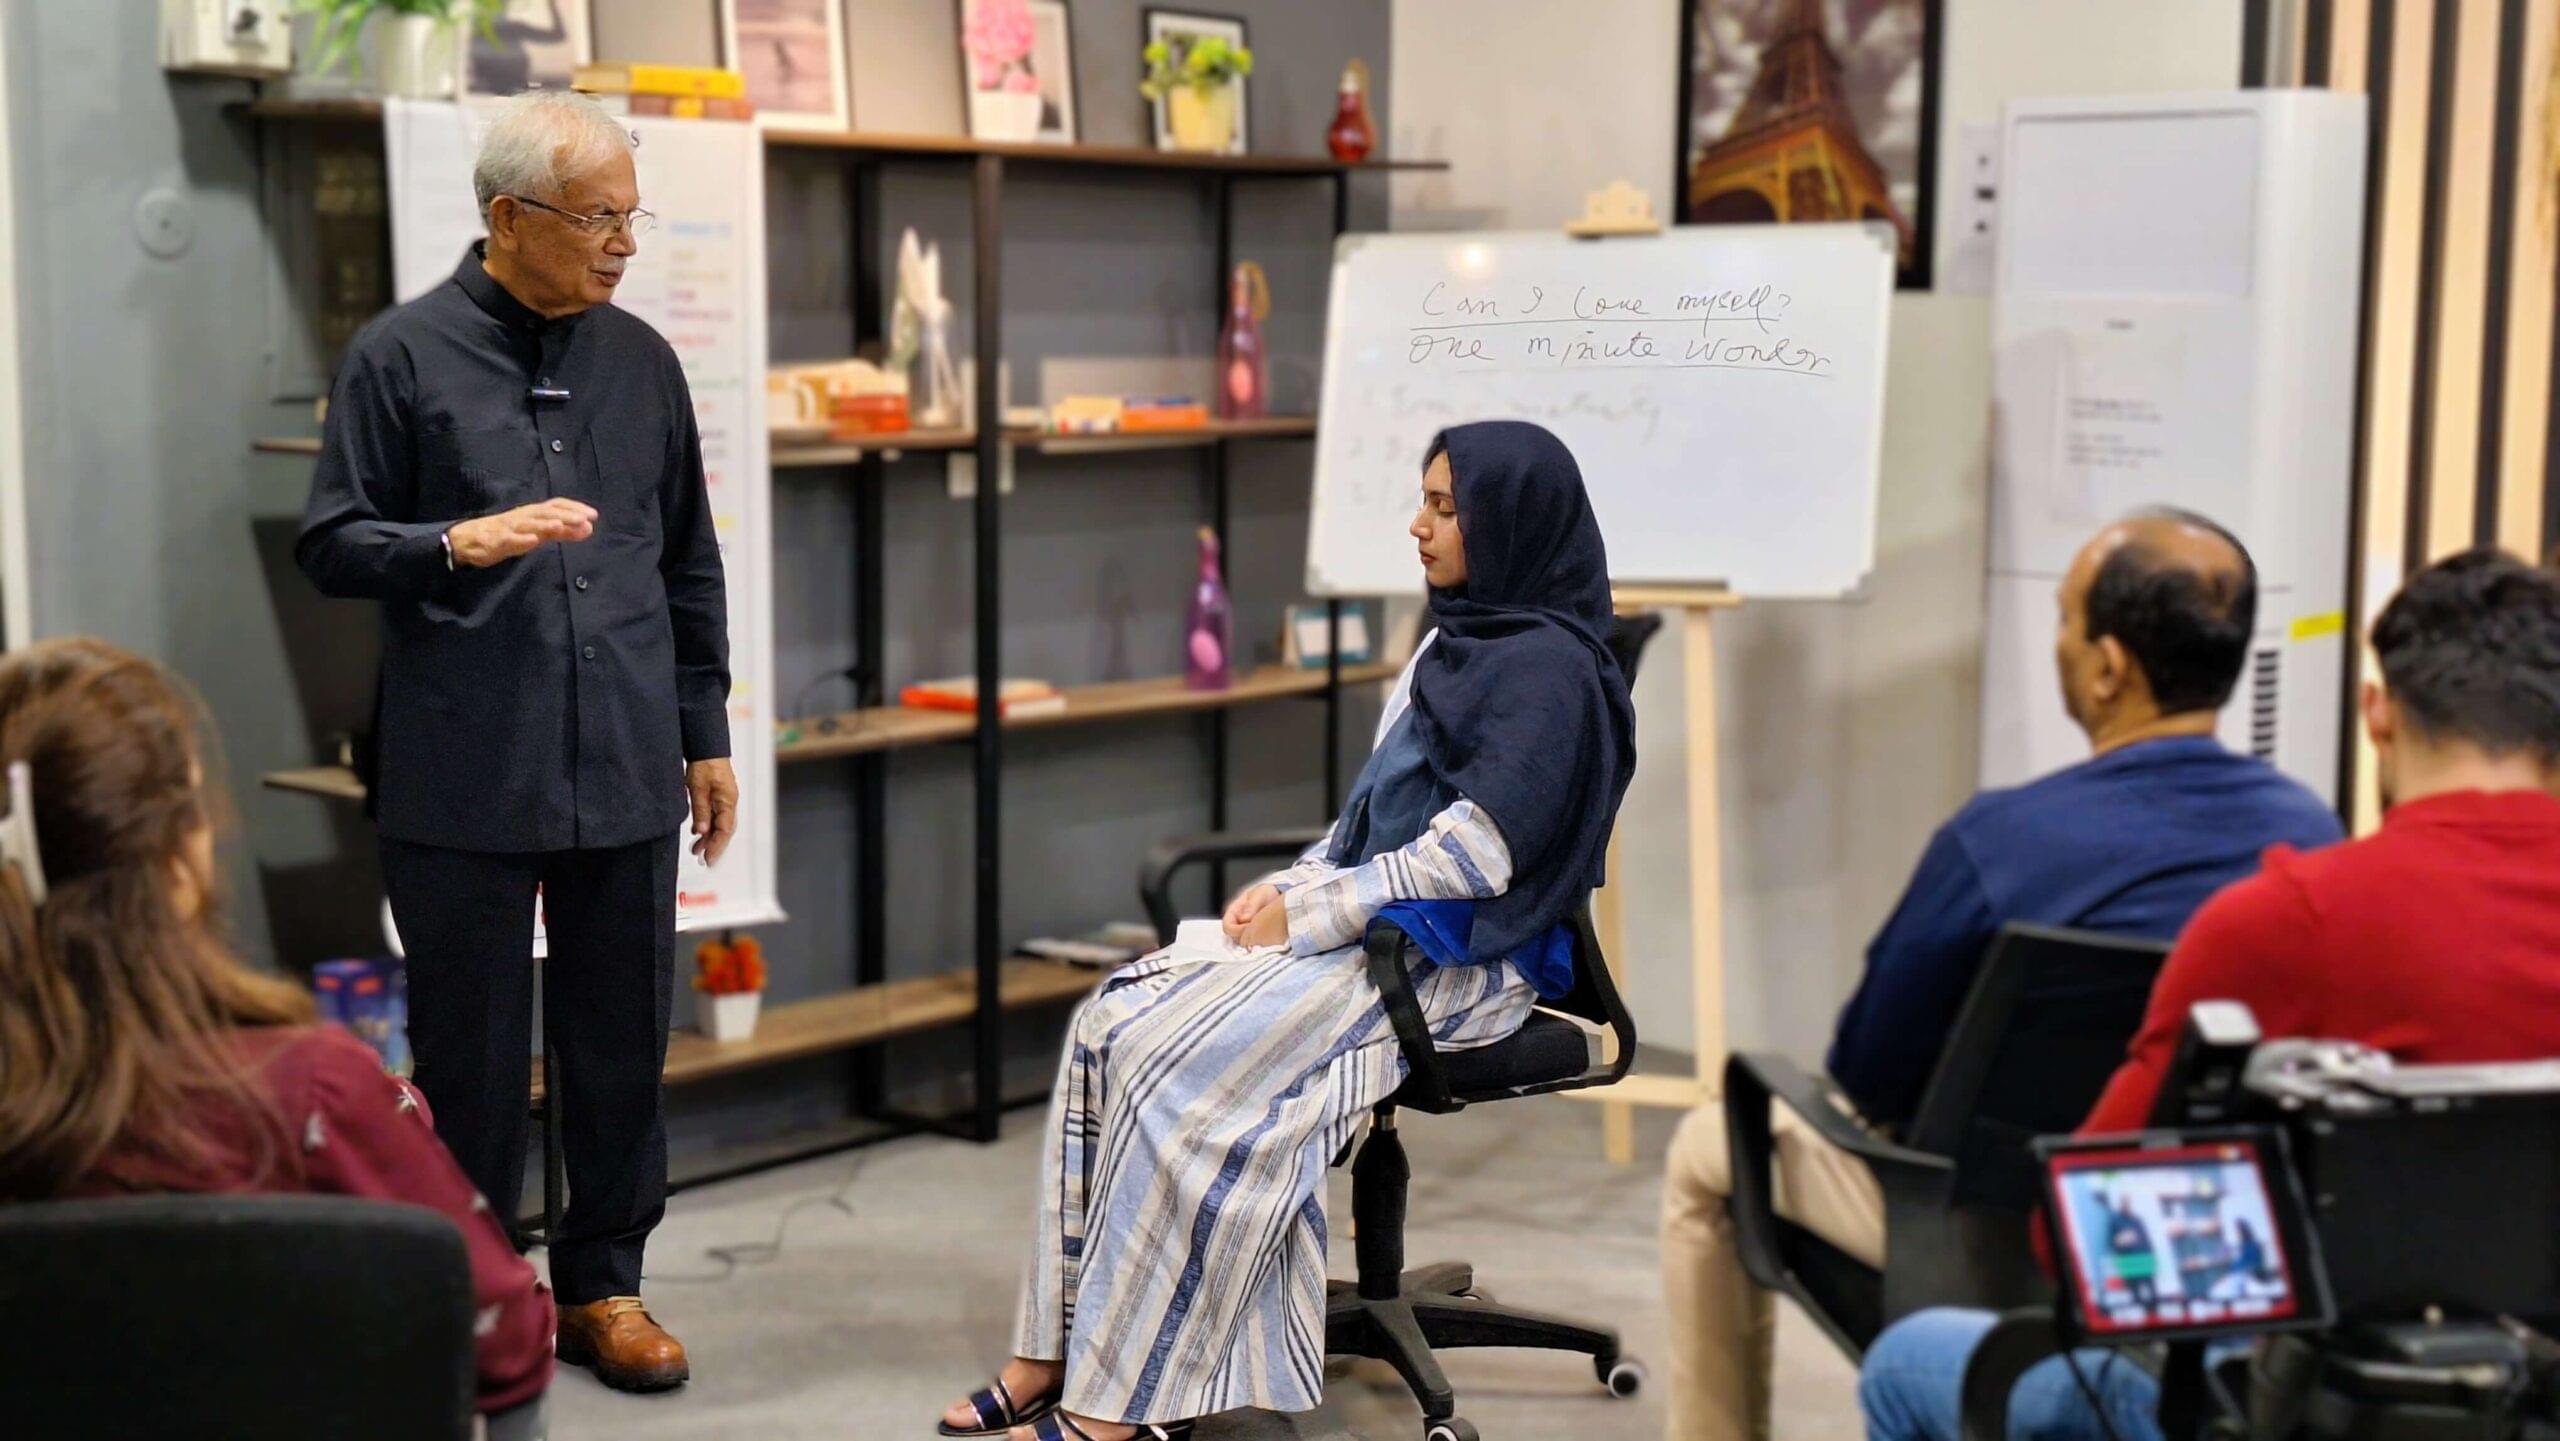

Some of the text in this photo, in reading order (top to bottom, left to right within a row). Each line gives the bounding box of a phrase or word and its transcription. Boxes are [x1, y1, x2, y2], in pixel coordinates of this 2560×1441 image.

[1422, 281, 1499, 317] Can
[1520, 286, 1544, 314] I
[1676, 284, 1792, 339] myself?
[1526, 329, 1661, 367] minute
